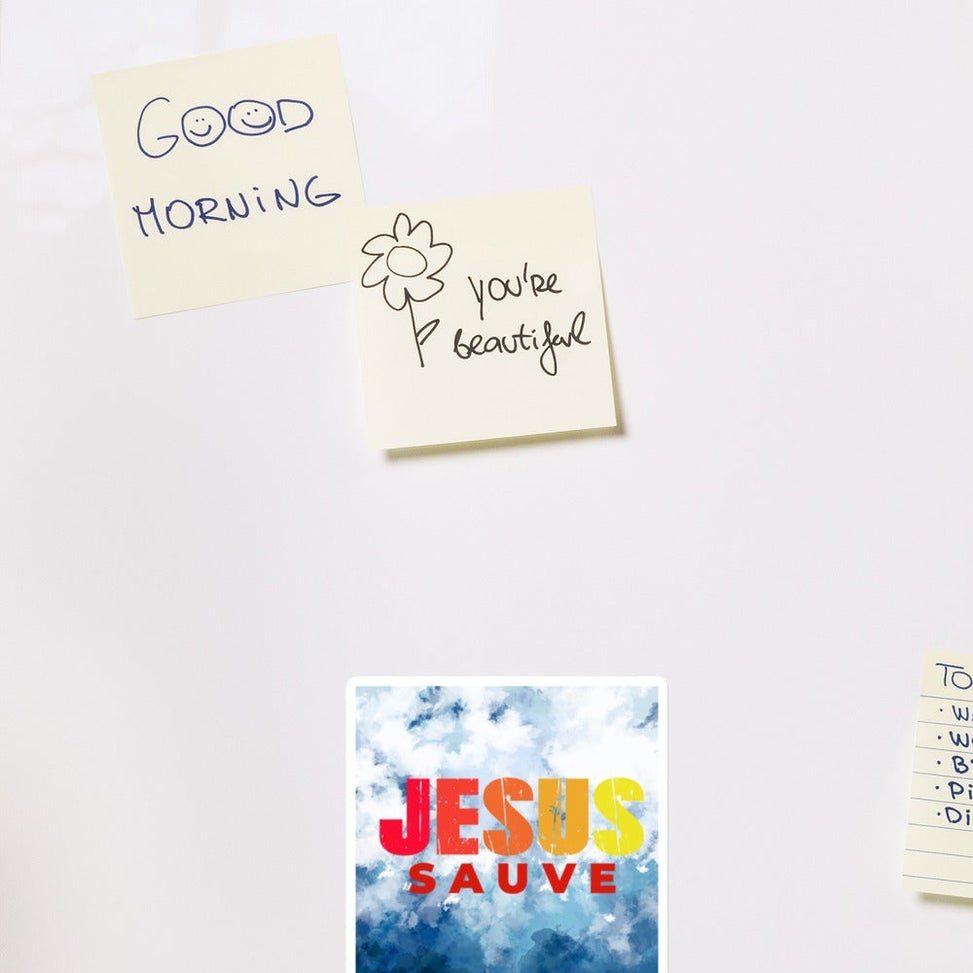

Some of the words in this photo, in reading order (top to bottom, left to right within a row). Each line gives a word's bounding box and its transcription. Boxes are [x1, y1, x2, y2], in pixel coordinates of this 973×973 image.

[136, 95, 315, 160] GOOD
[451, 310, 593, 377] beautiful
[935, 662, 973, 690] TO
[379, 777, 645, 856] JESUS
[408, 862, 617, 894] SAUVE
